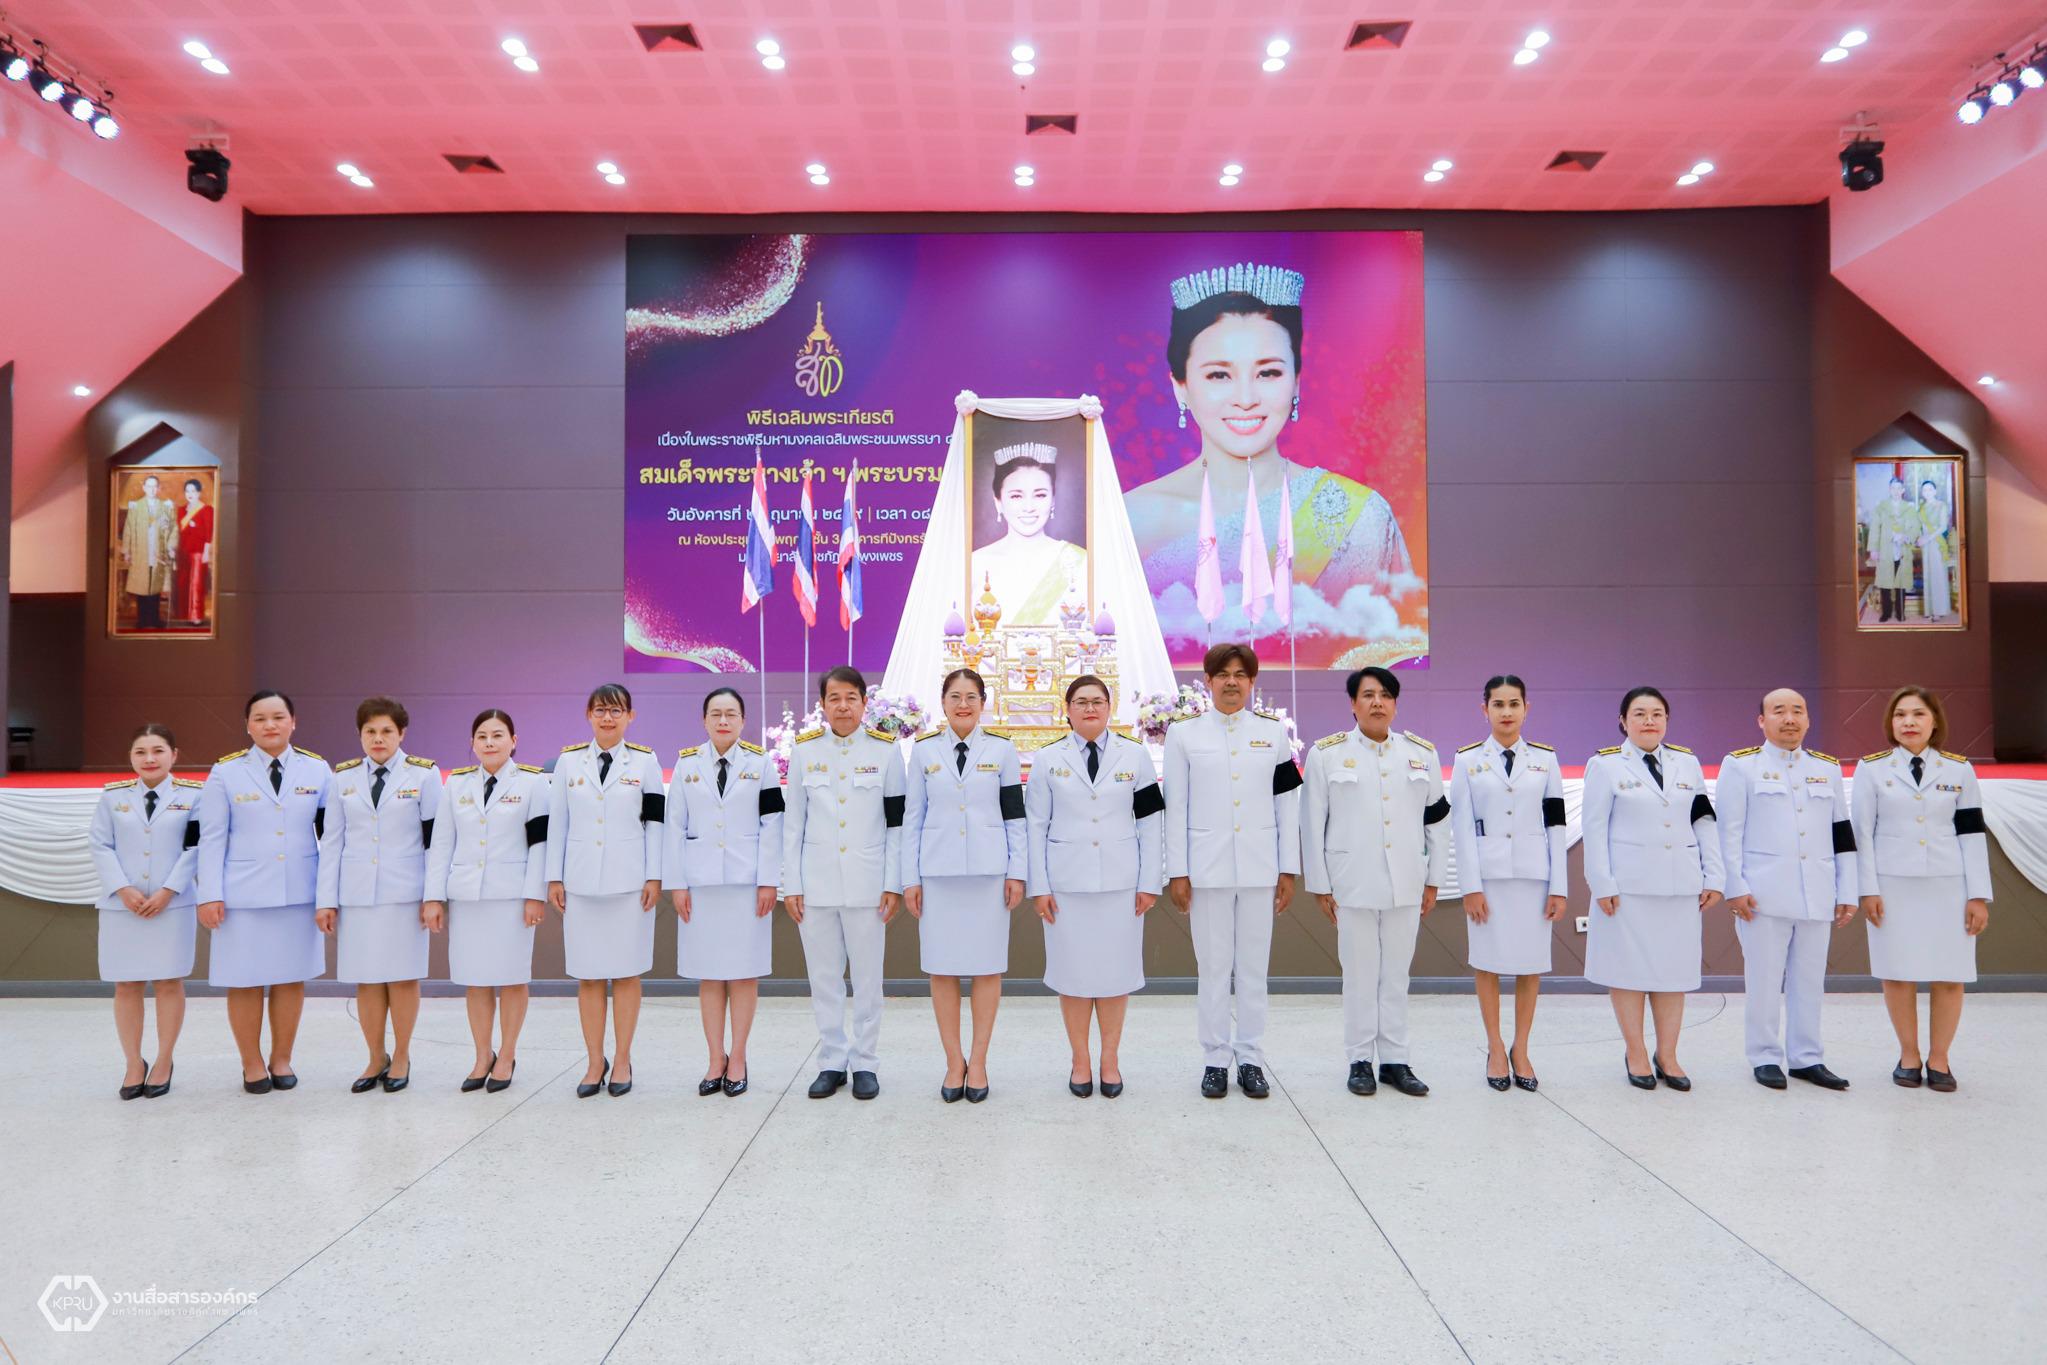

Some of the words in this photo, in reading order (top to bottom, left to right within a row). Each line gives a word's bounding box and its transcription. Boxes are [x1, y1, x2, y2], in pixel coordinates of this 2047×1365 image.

[747, 409, 894, 425] พิธีเฉลิมพระเกียรติ
[667, 504, 741, 521] วันอังคารที่
[876, 508, 907, 520] เวลา
